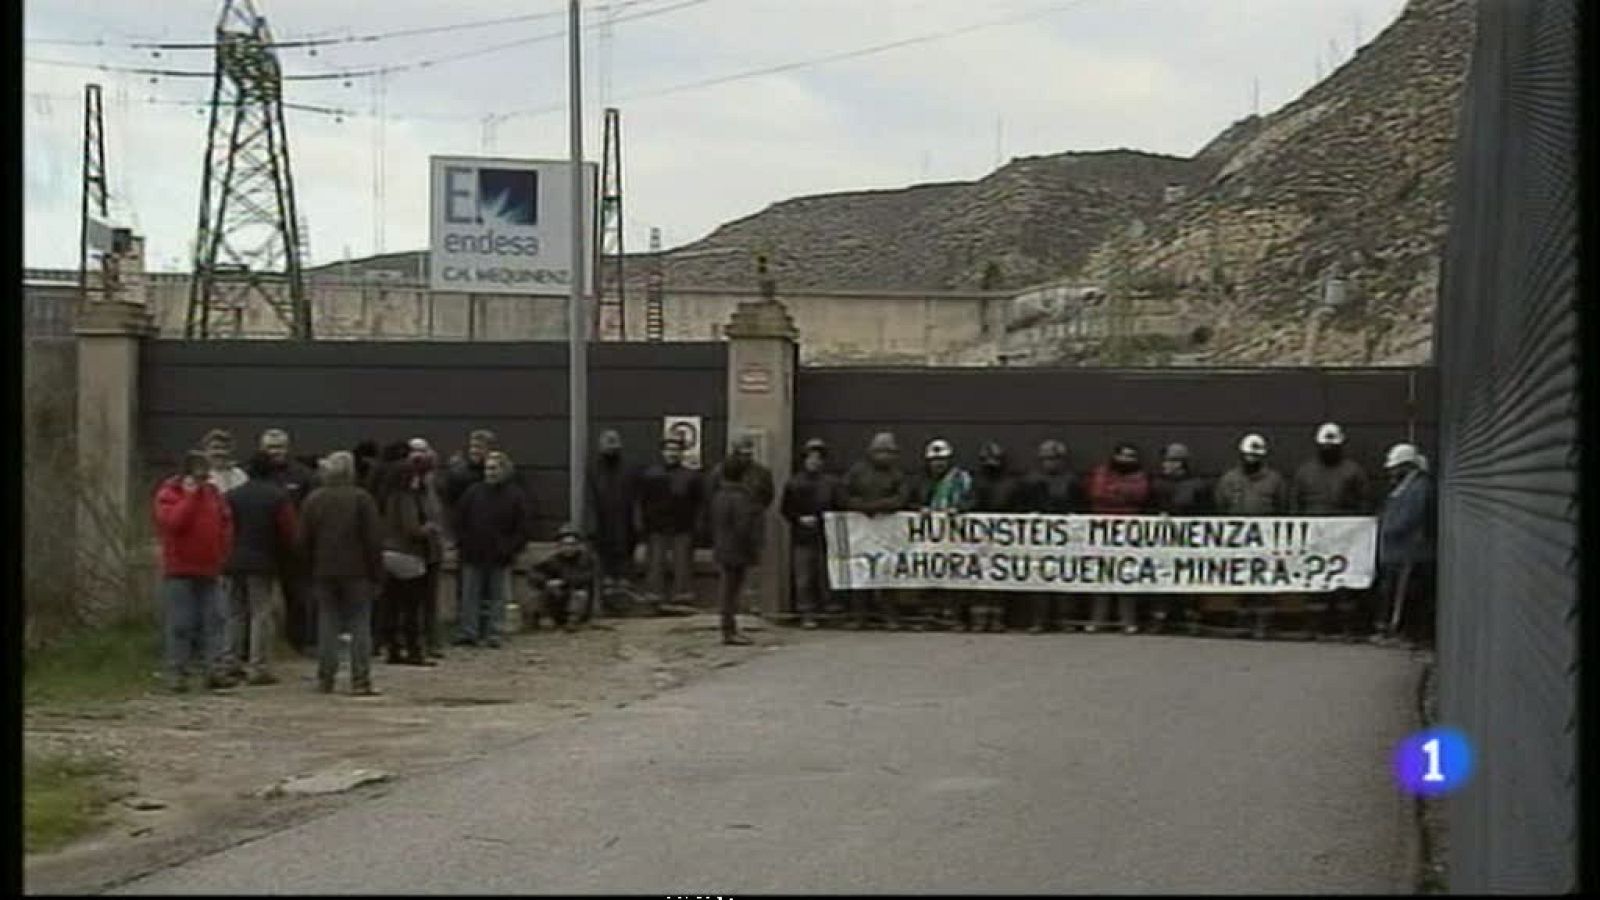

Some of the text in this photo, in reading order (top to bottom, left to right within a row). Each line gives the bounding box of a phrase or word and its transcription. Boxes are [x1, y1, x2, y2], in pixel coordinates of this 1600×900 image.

[444, 230, 538, 256] endesa
[476, 267, 573, 285] MEQUINENZ
[894, 552, 984, 579] AHORA
